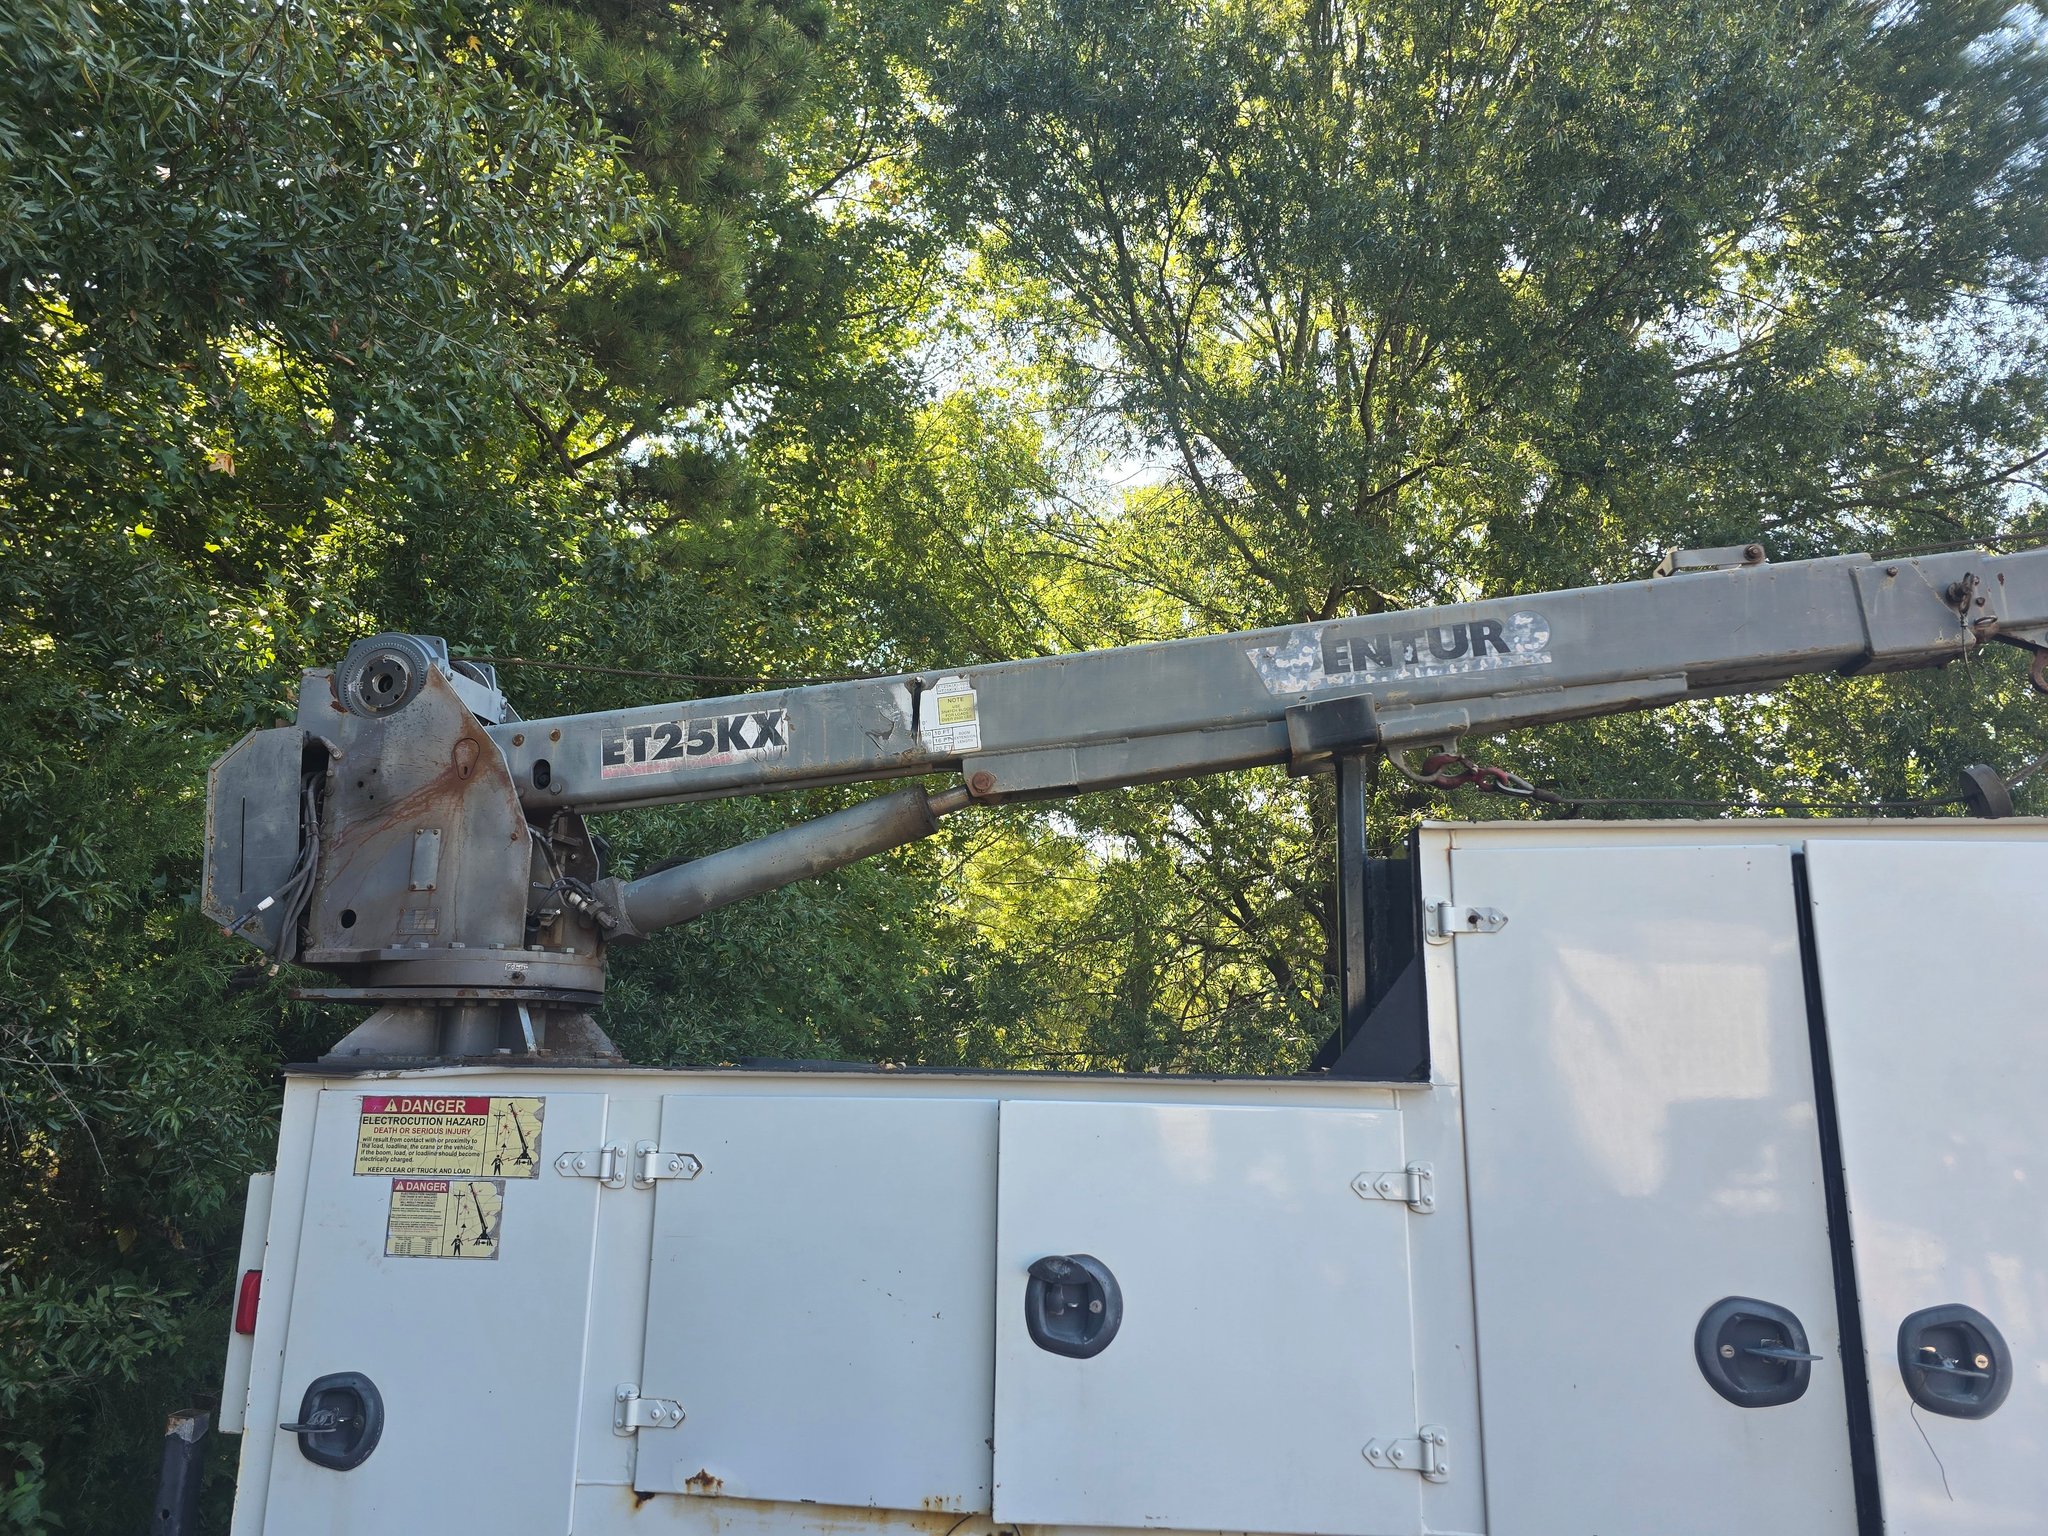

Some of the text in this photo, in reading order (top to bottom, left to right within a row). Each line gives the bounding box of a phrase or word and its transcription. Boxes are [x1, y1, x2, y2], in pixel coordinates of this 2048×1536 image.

[602, 710, 787, 766] ET25KX
[401, 1099, 466, 1113] DANGER
[362, 1116, 486, 1126] ELECTROCUTION HAZARD
[373, 1126, 398, 1134] DEATH
[411, 1127, 444, 1135] SERIOUS
[405, 1182, 447, 1191] DANGER
